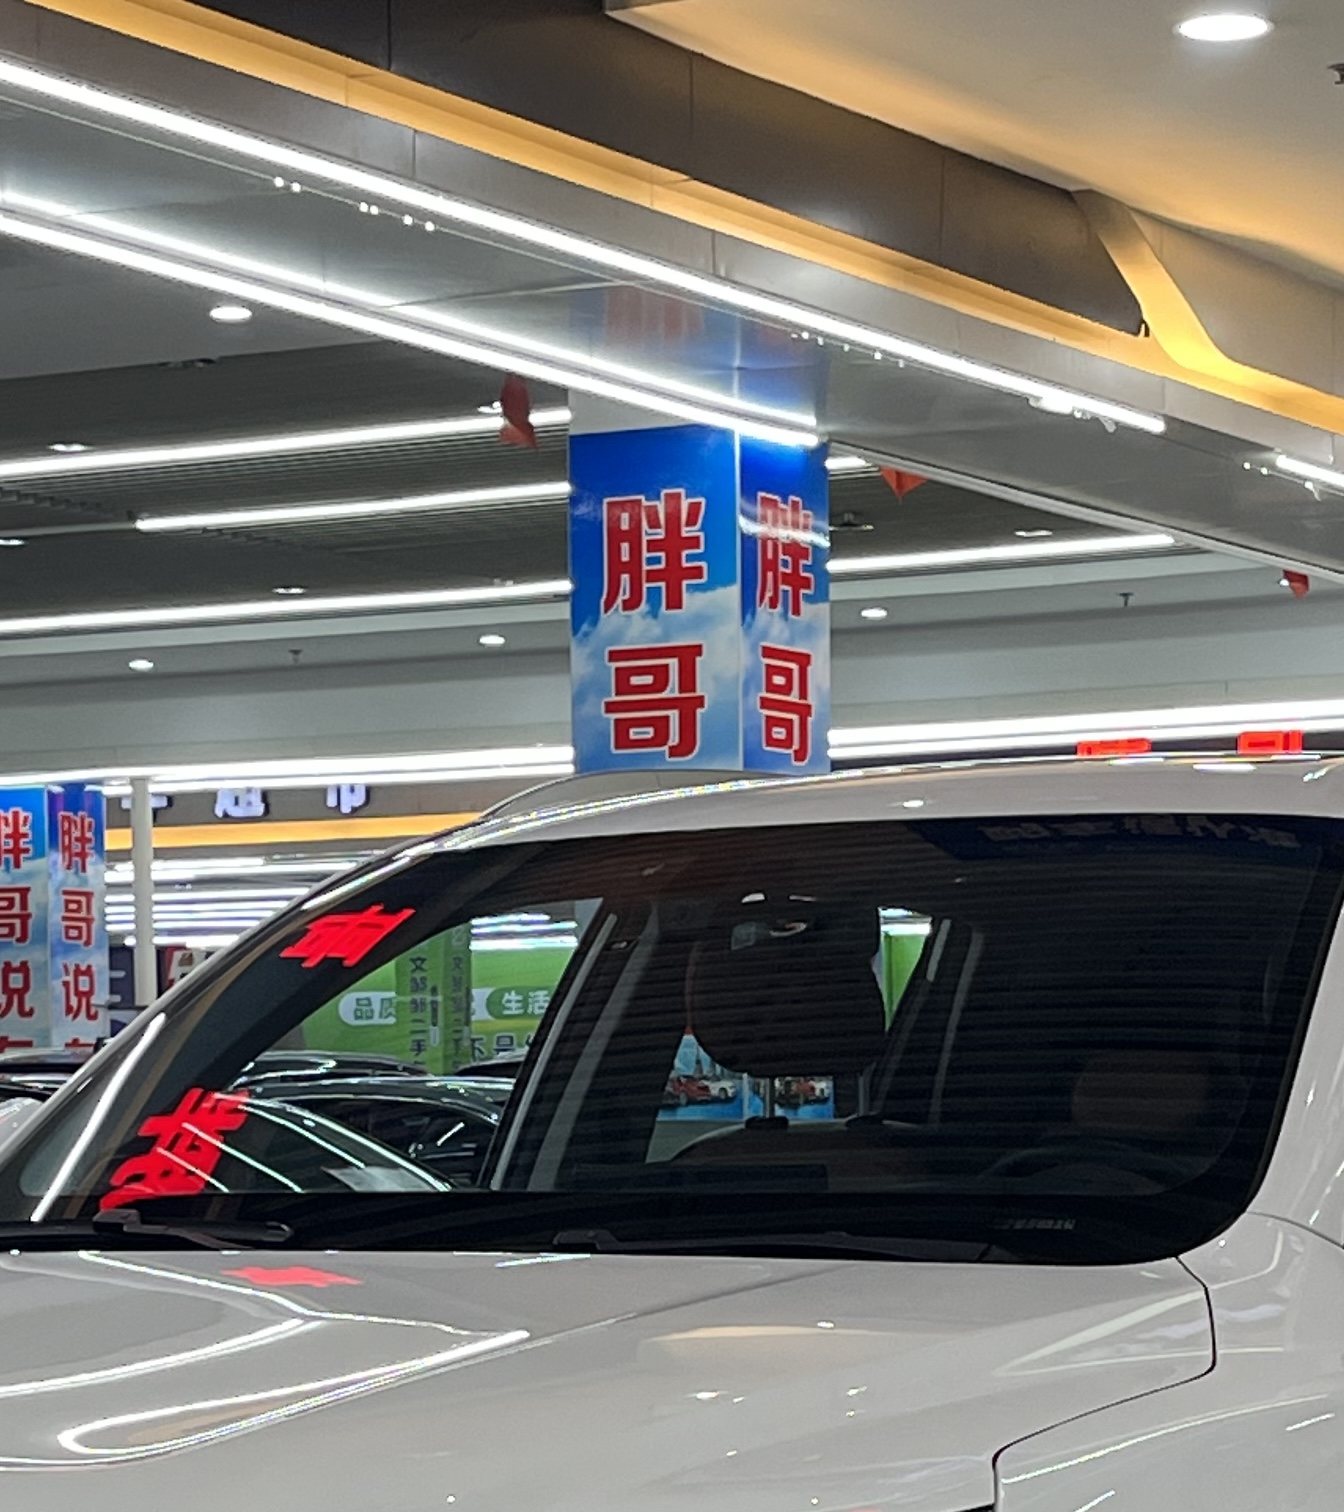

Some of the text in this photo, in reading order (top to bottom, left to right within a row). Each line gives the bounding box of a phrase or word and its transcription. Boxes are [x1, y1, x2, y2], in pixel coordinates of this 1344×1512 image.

[600, 487, 707, 762] 胖哥
[756, 491, 815, 765] 胖哥
[58, 810, 100, 1051] 胖哥说
